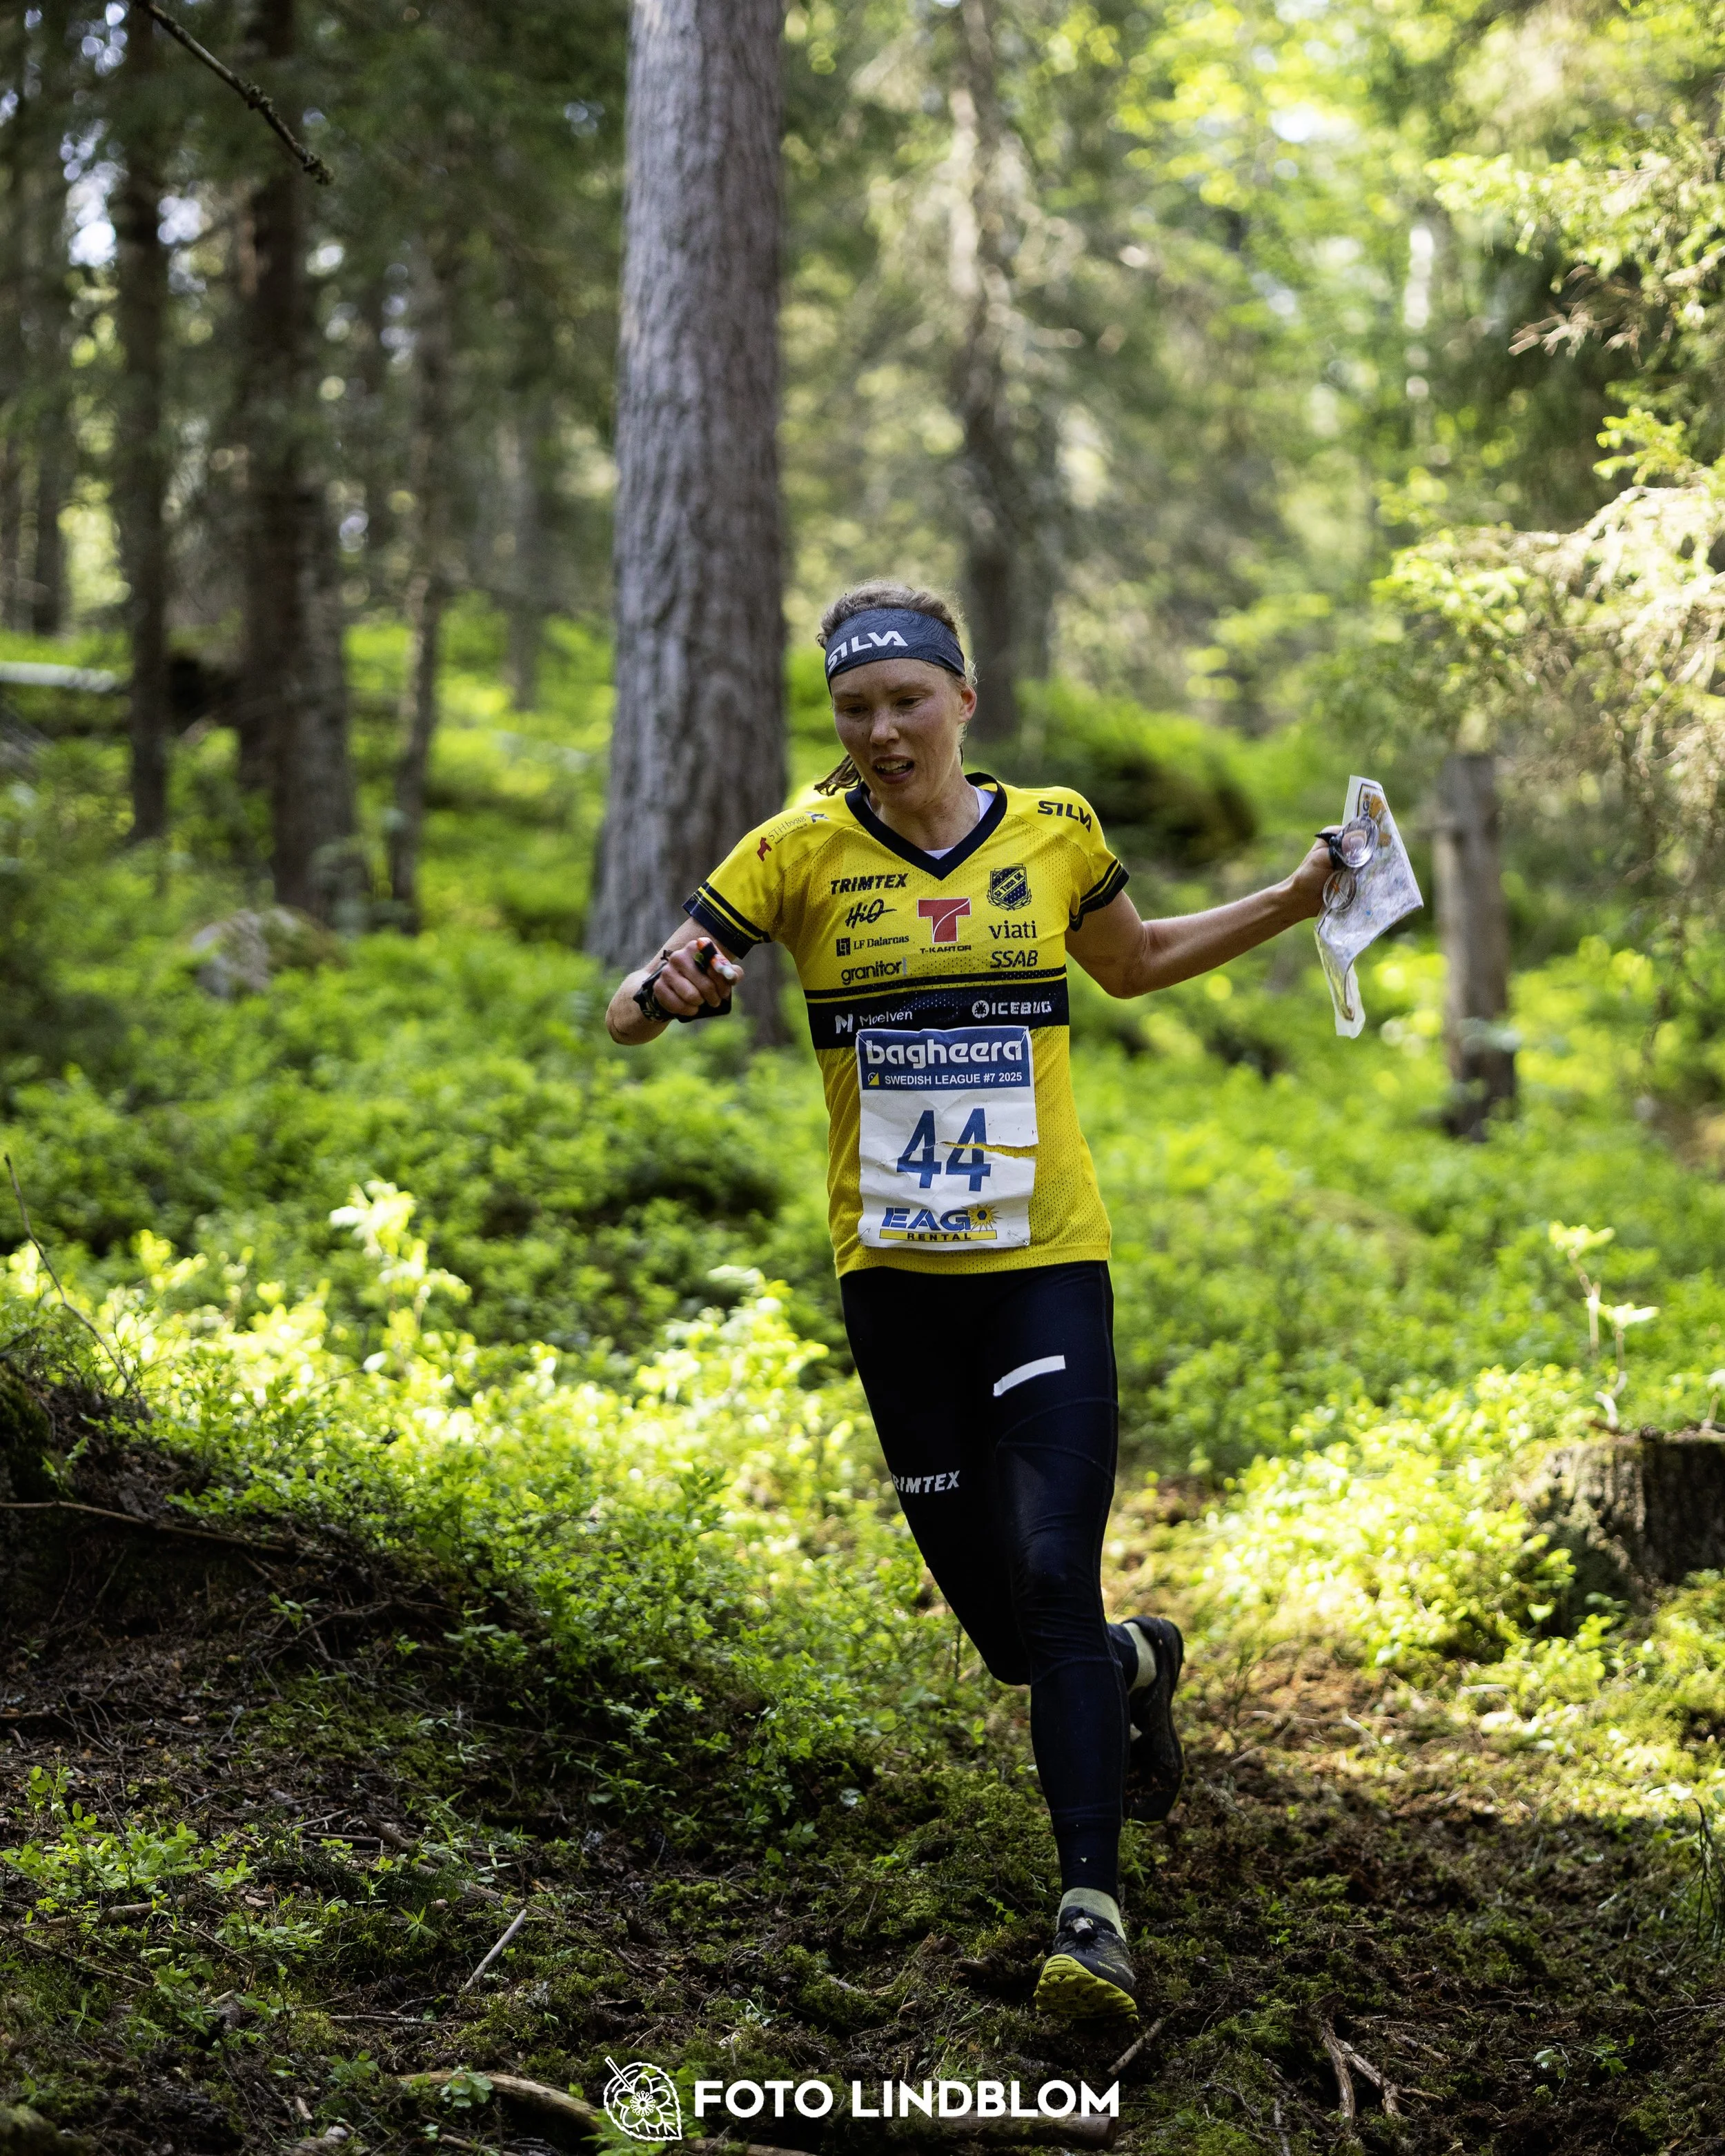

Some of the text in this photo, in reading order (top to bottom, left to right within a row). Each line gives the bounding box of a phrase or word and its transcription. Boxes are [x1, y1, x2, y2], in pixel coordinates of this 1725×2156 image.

[831, 873, 909, 895] TRIMTEX
[988, 920, 1038, 939] viati
[920, 945, 972, 954] T-KARTOR
[989, 950, 1038, 969] SSAB
[840, 960, 902, 985] granitor
[992, 1001, 1052, 1015] ICEBUG
[860, 1011, 913, 1027] Moelven
[866, 1039, 1023, 1069] bagheera
[885, 1072, 1023, 1085] SWEDISH LEAGUE #7 2025
[896, 1108, 992, 1191] 44
[907, 1232, 972, 1240] RENTAL
[892, 1470, 960, 1493] RIMTEX
